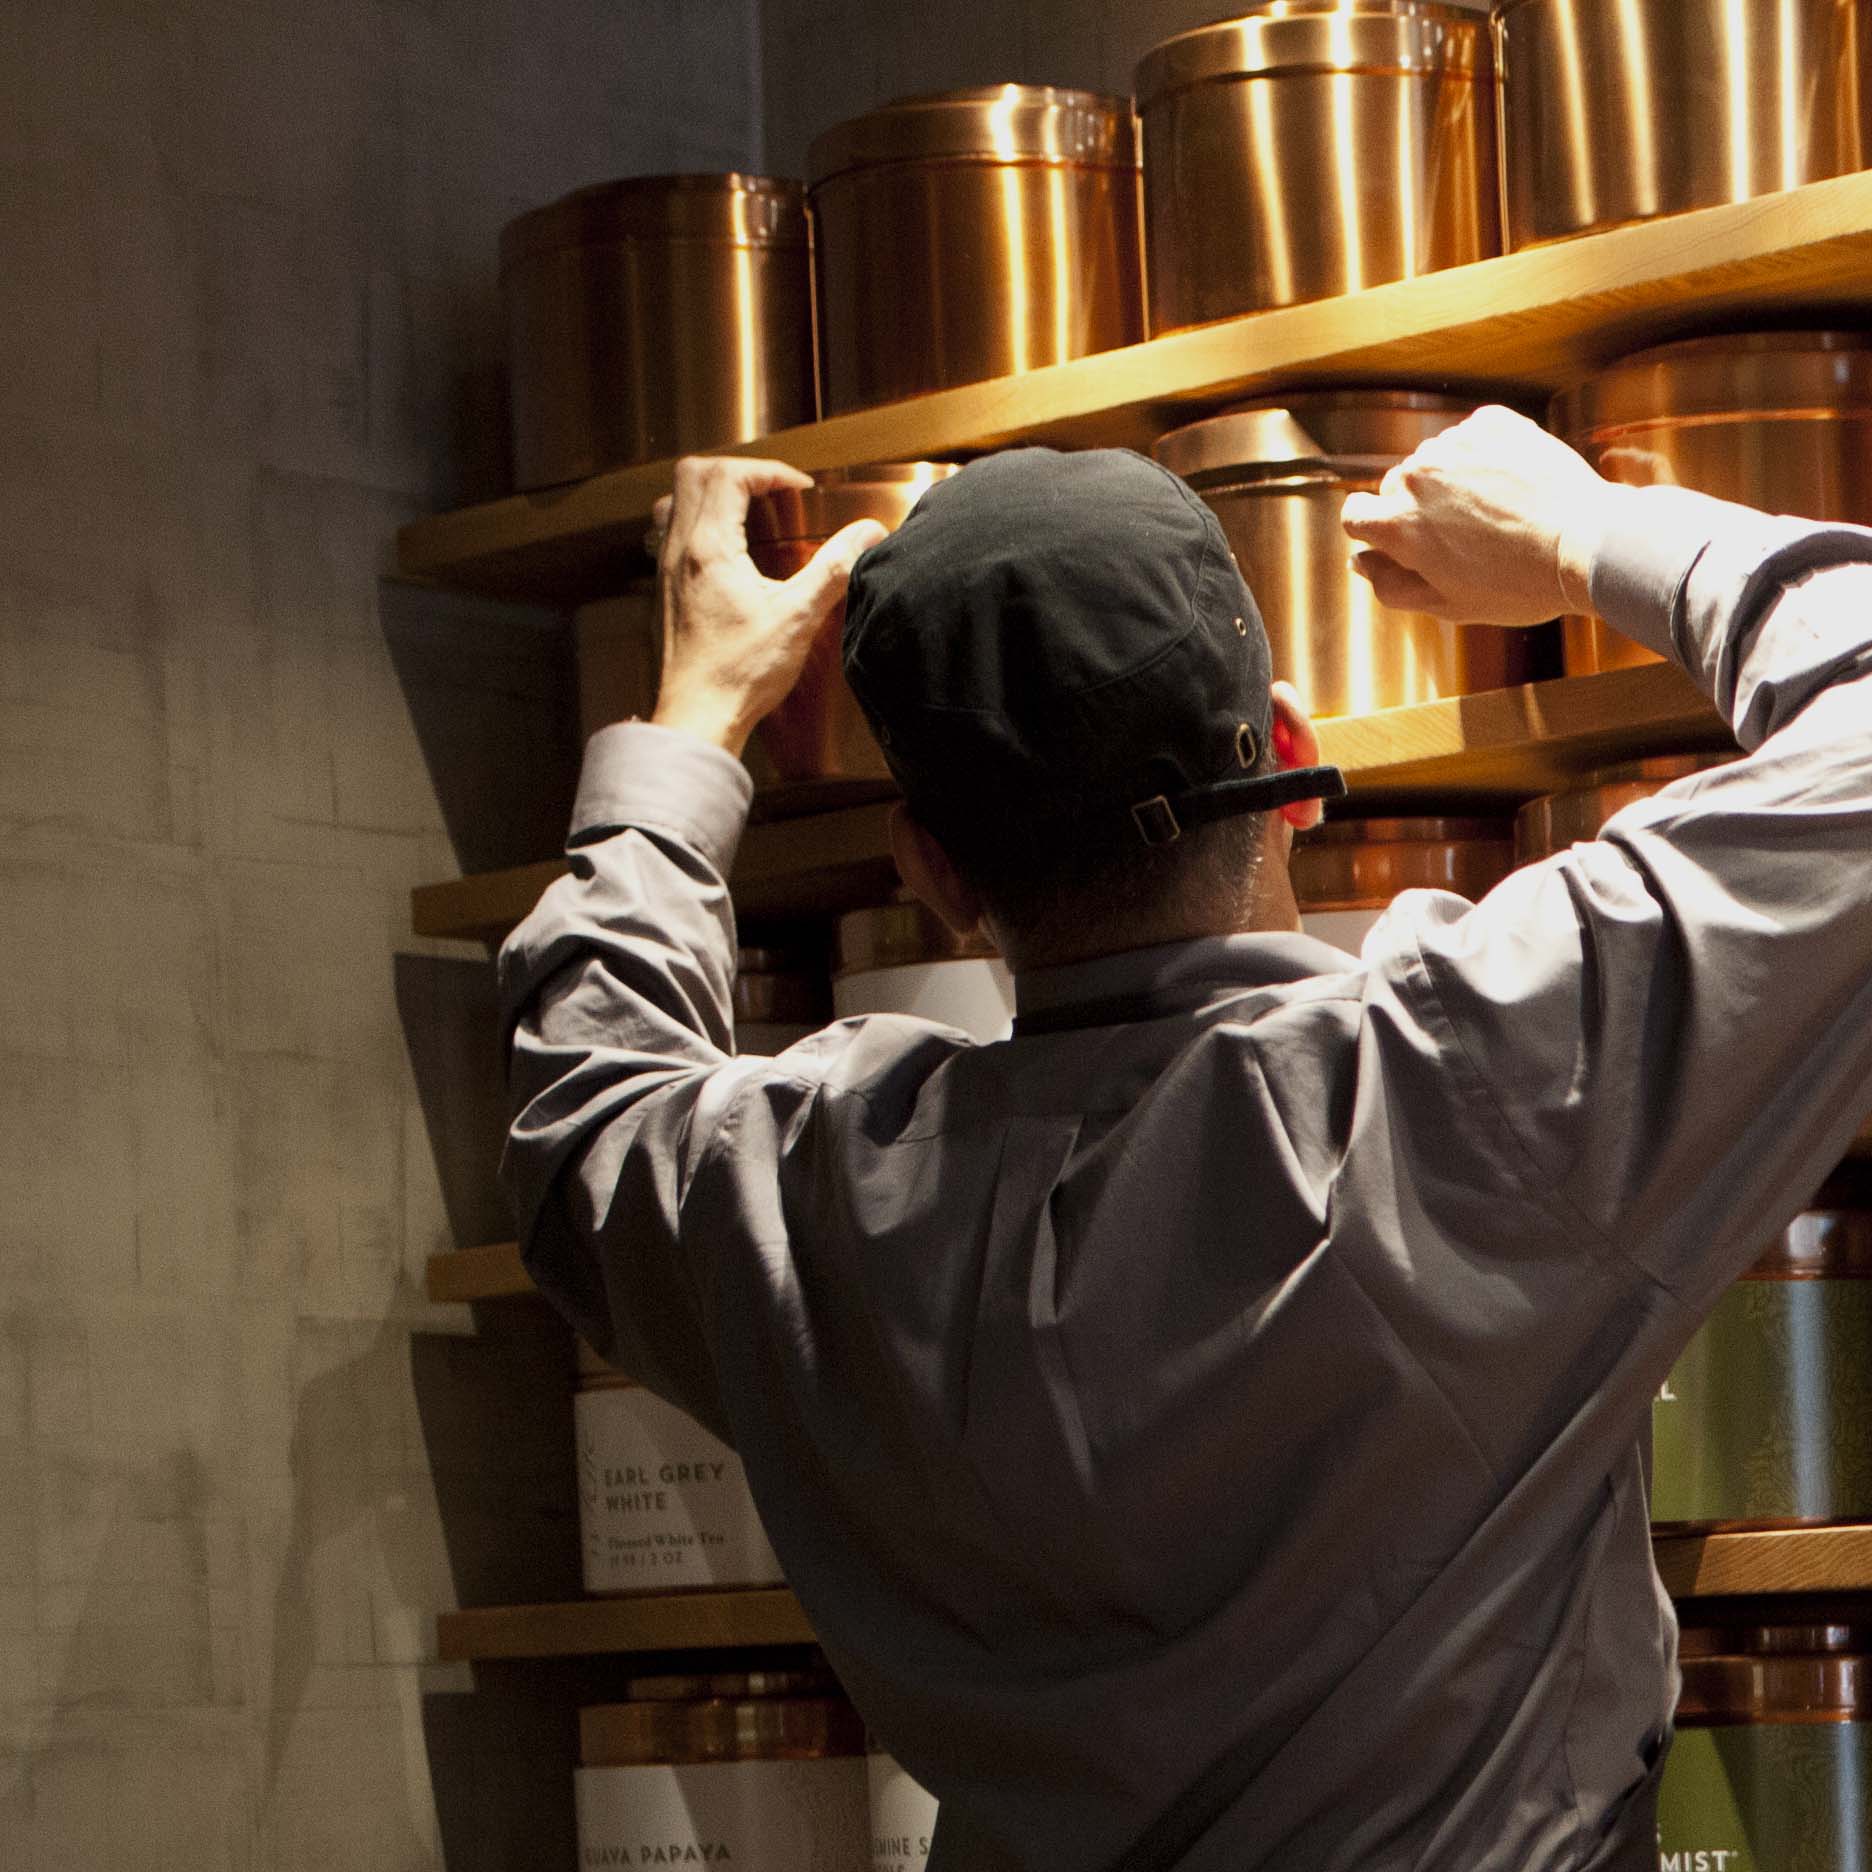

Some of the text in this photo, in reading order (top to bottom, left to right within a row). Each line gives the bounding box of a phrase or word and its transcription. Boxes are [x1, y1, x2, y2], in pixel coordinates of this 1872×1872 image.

[605, 1462, 724, 1487] EARL GREY
[606, 1492, 666, 1512] WHITE
[641, 1842, 732, 1862] PAPAYA
